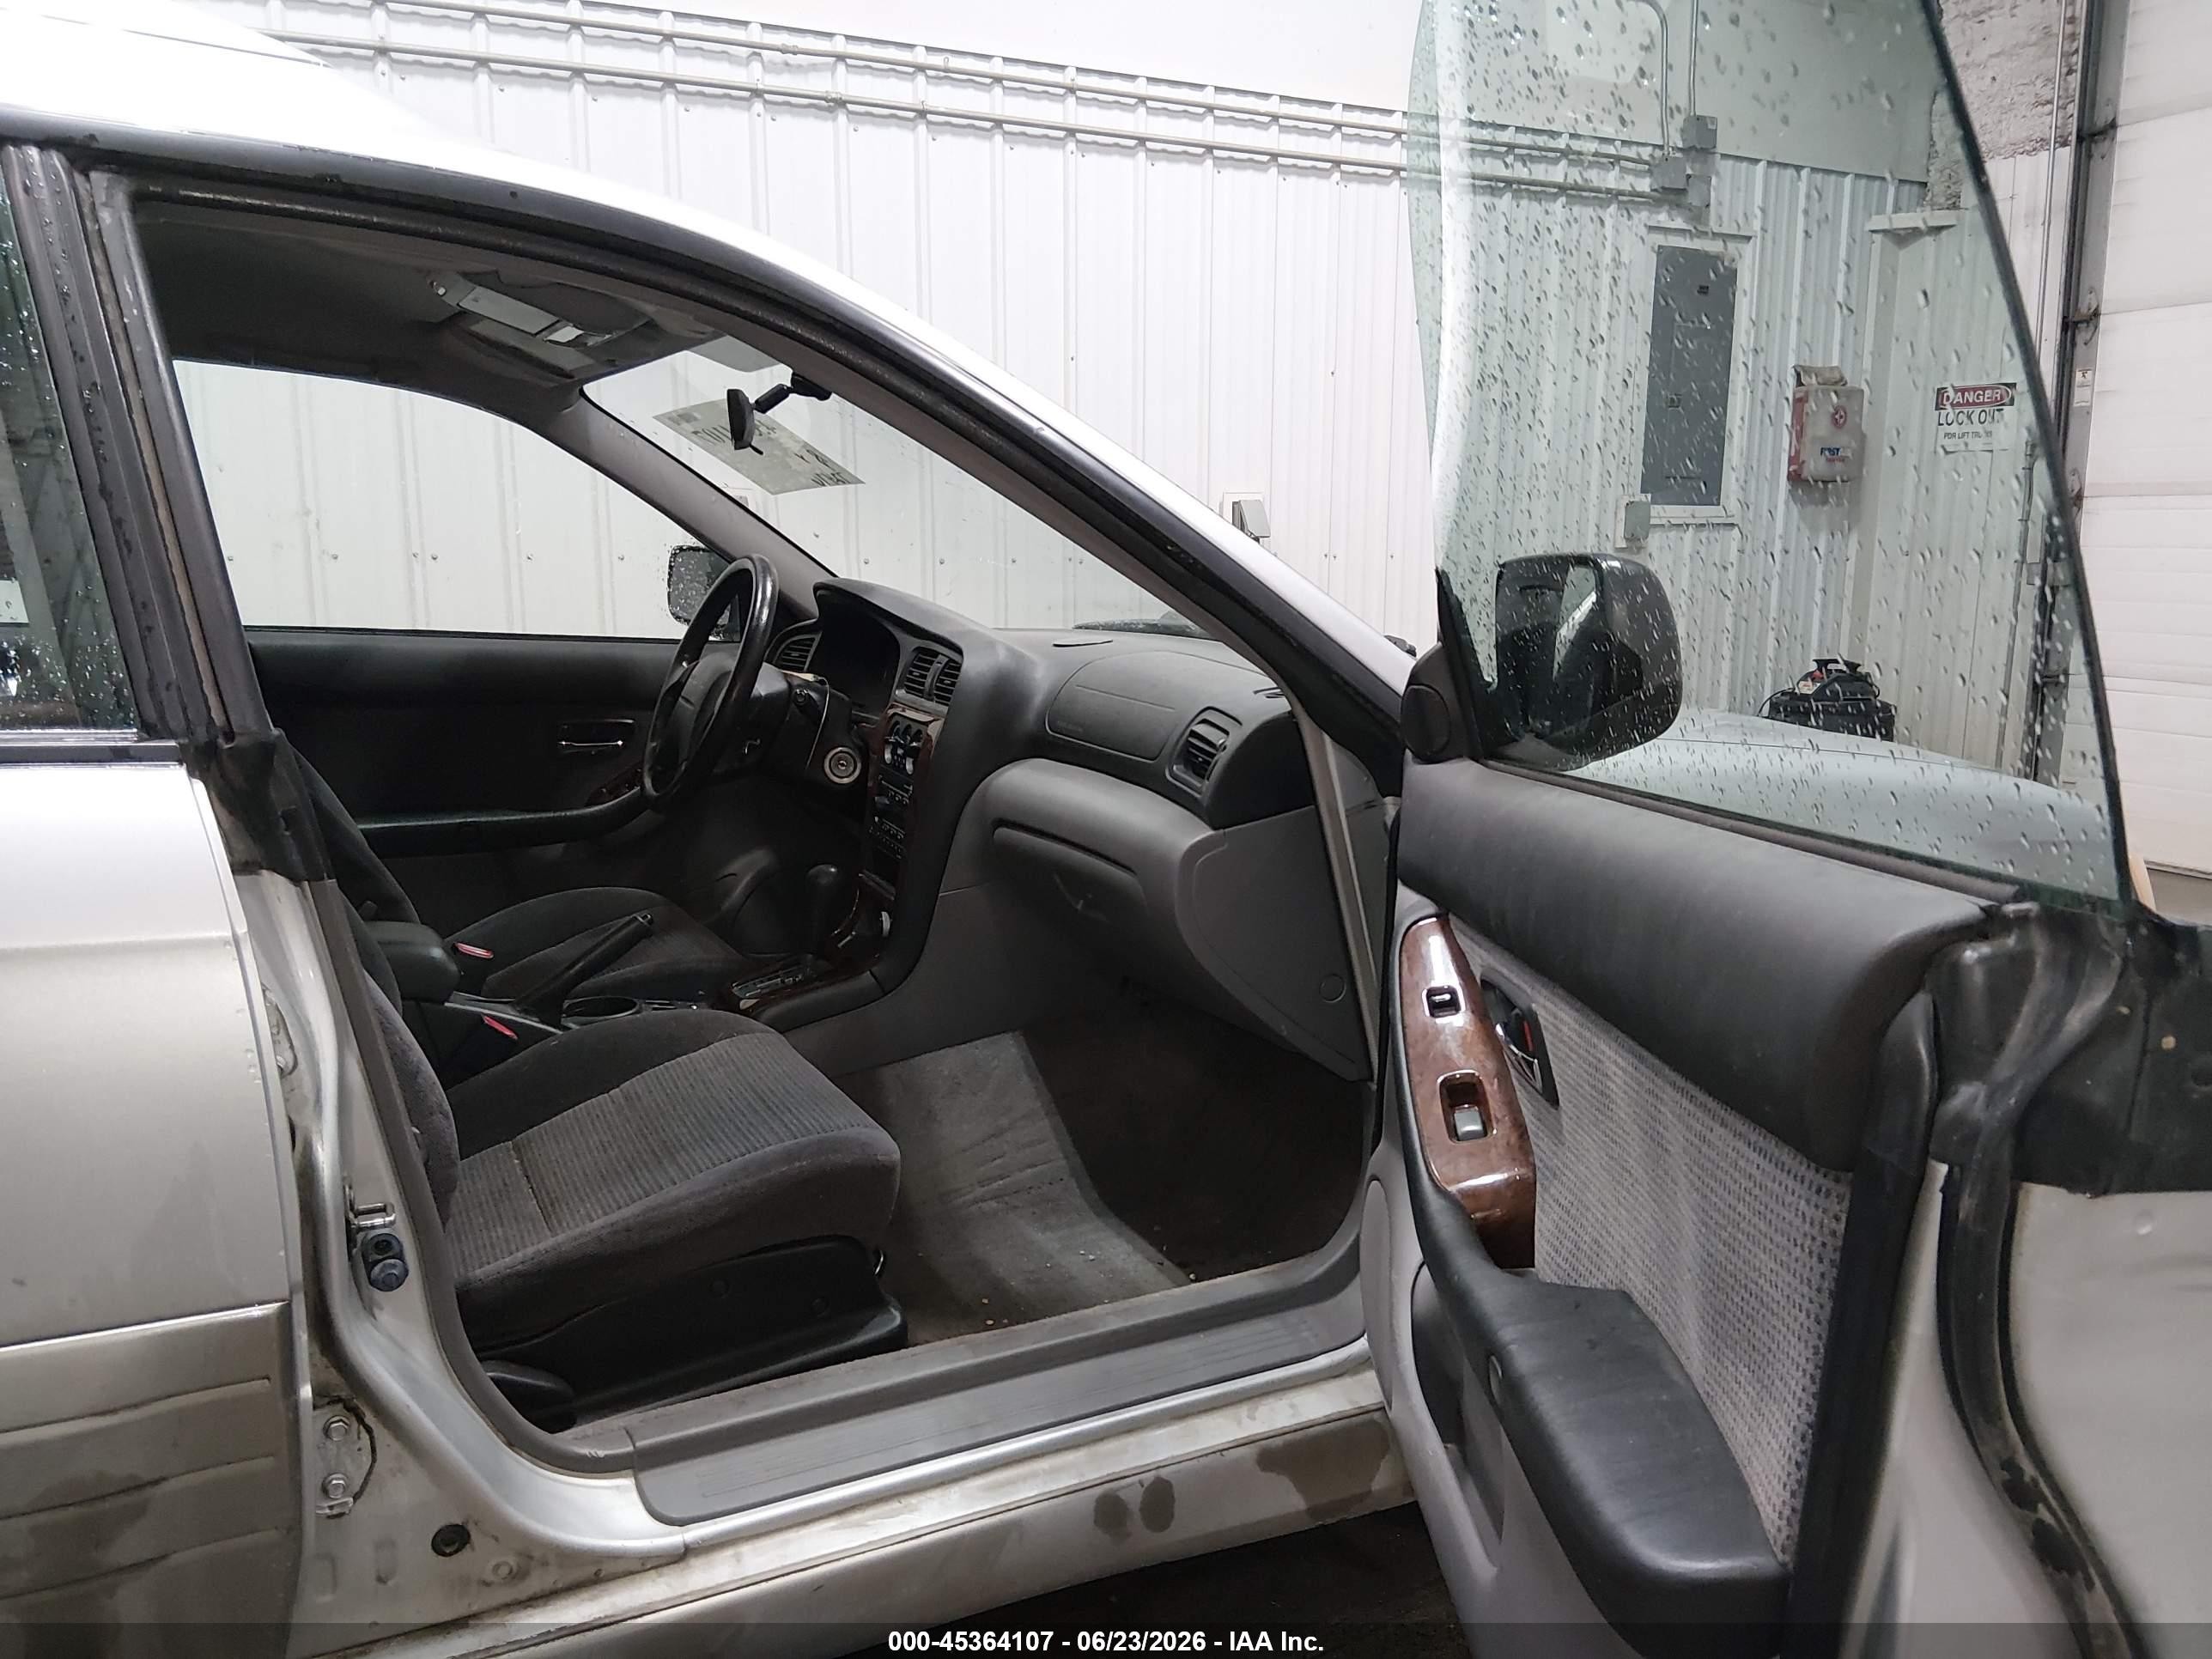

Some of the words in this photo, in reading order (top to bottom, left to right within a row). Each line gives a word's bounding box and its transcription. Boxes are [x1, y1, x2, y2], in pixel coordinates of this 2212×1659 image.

[1942, 389, 2002, 405] DANGER
[1937, 410, 1975, 427] LOCK
[1978, 408, 2004, 425] OUT
[1958, 431, 1970, 440] LIFT
[1972, 430, 1993, 439] TRUKS
